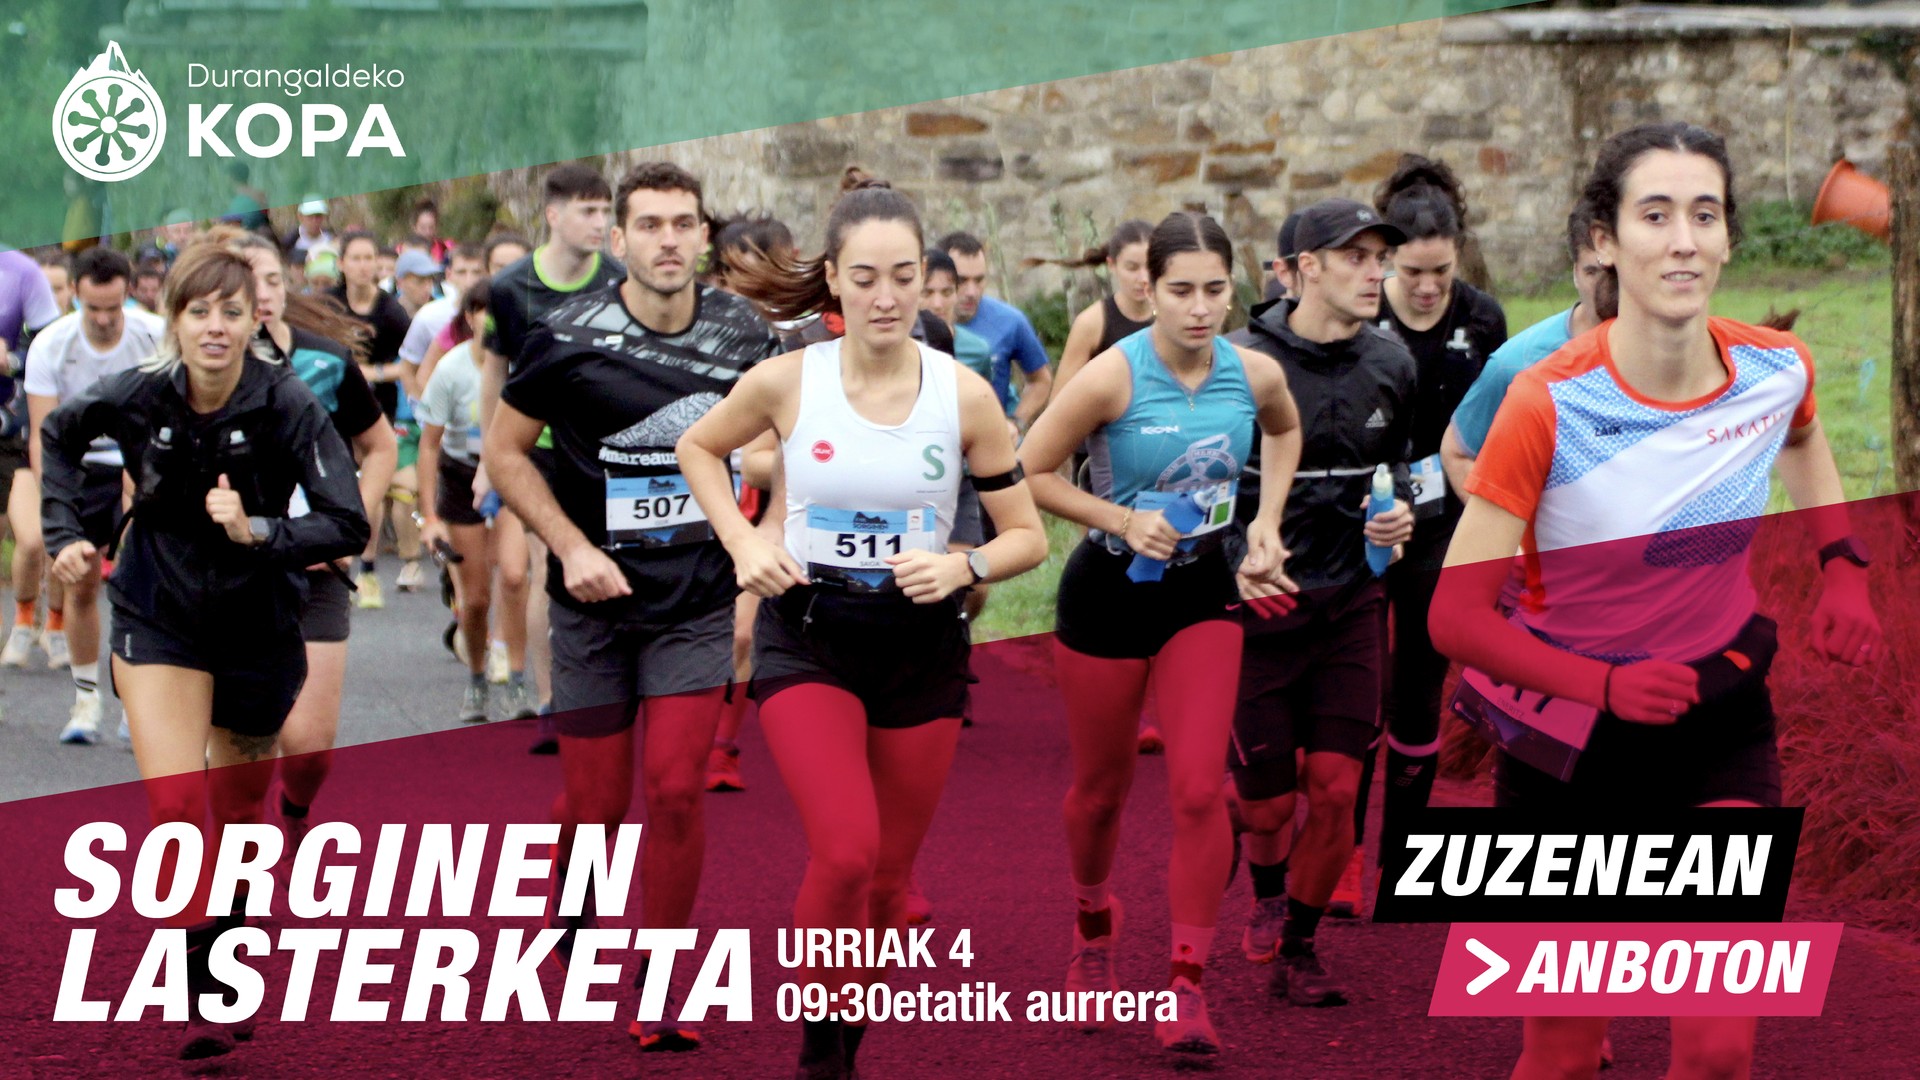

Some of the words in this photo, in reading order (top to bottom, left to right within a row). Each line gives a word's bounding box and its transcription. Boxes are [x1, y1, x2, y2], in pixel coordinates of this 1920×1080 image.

[922, 444, 946, 481] S
[633, 494, 691, 519] 507
[834, 533, 901, 558] 511
